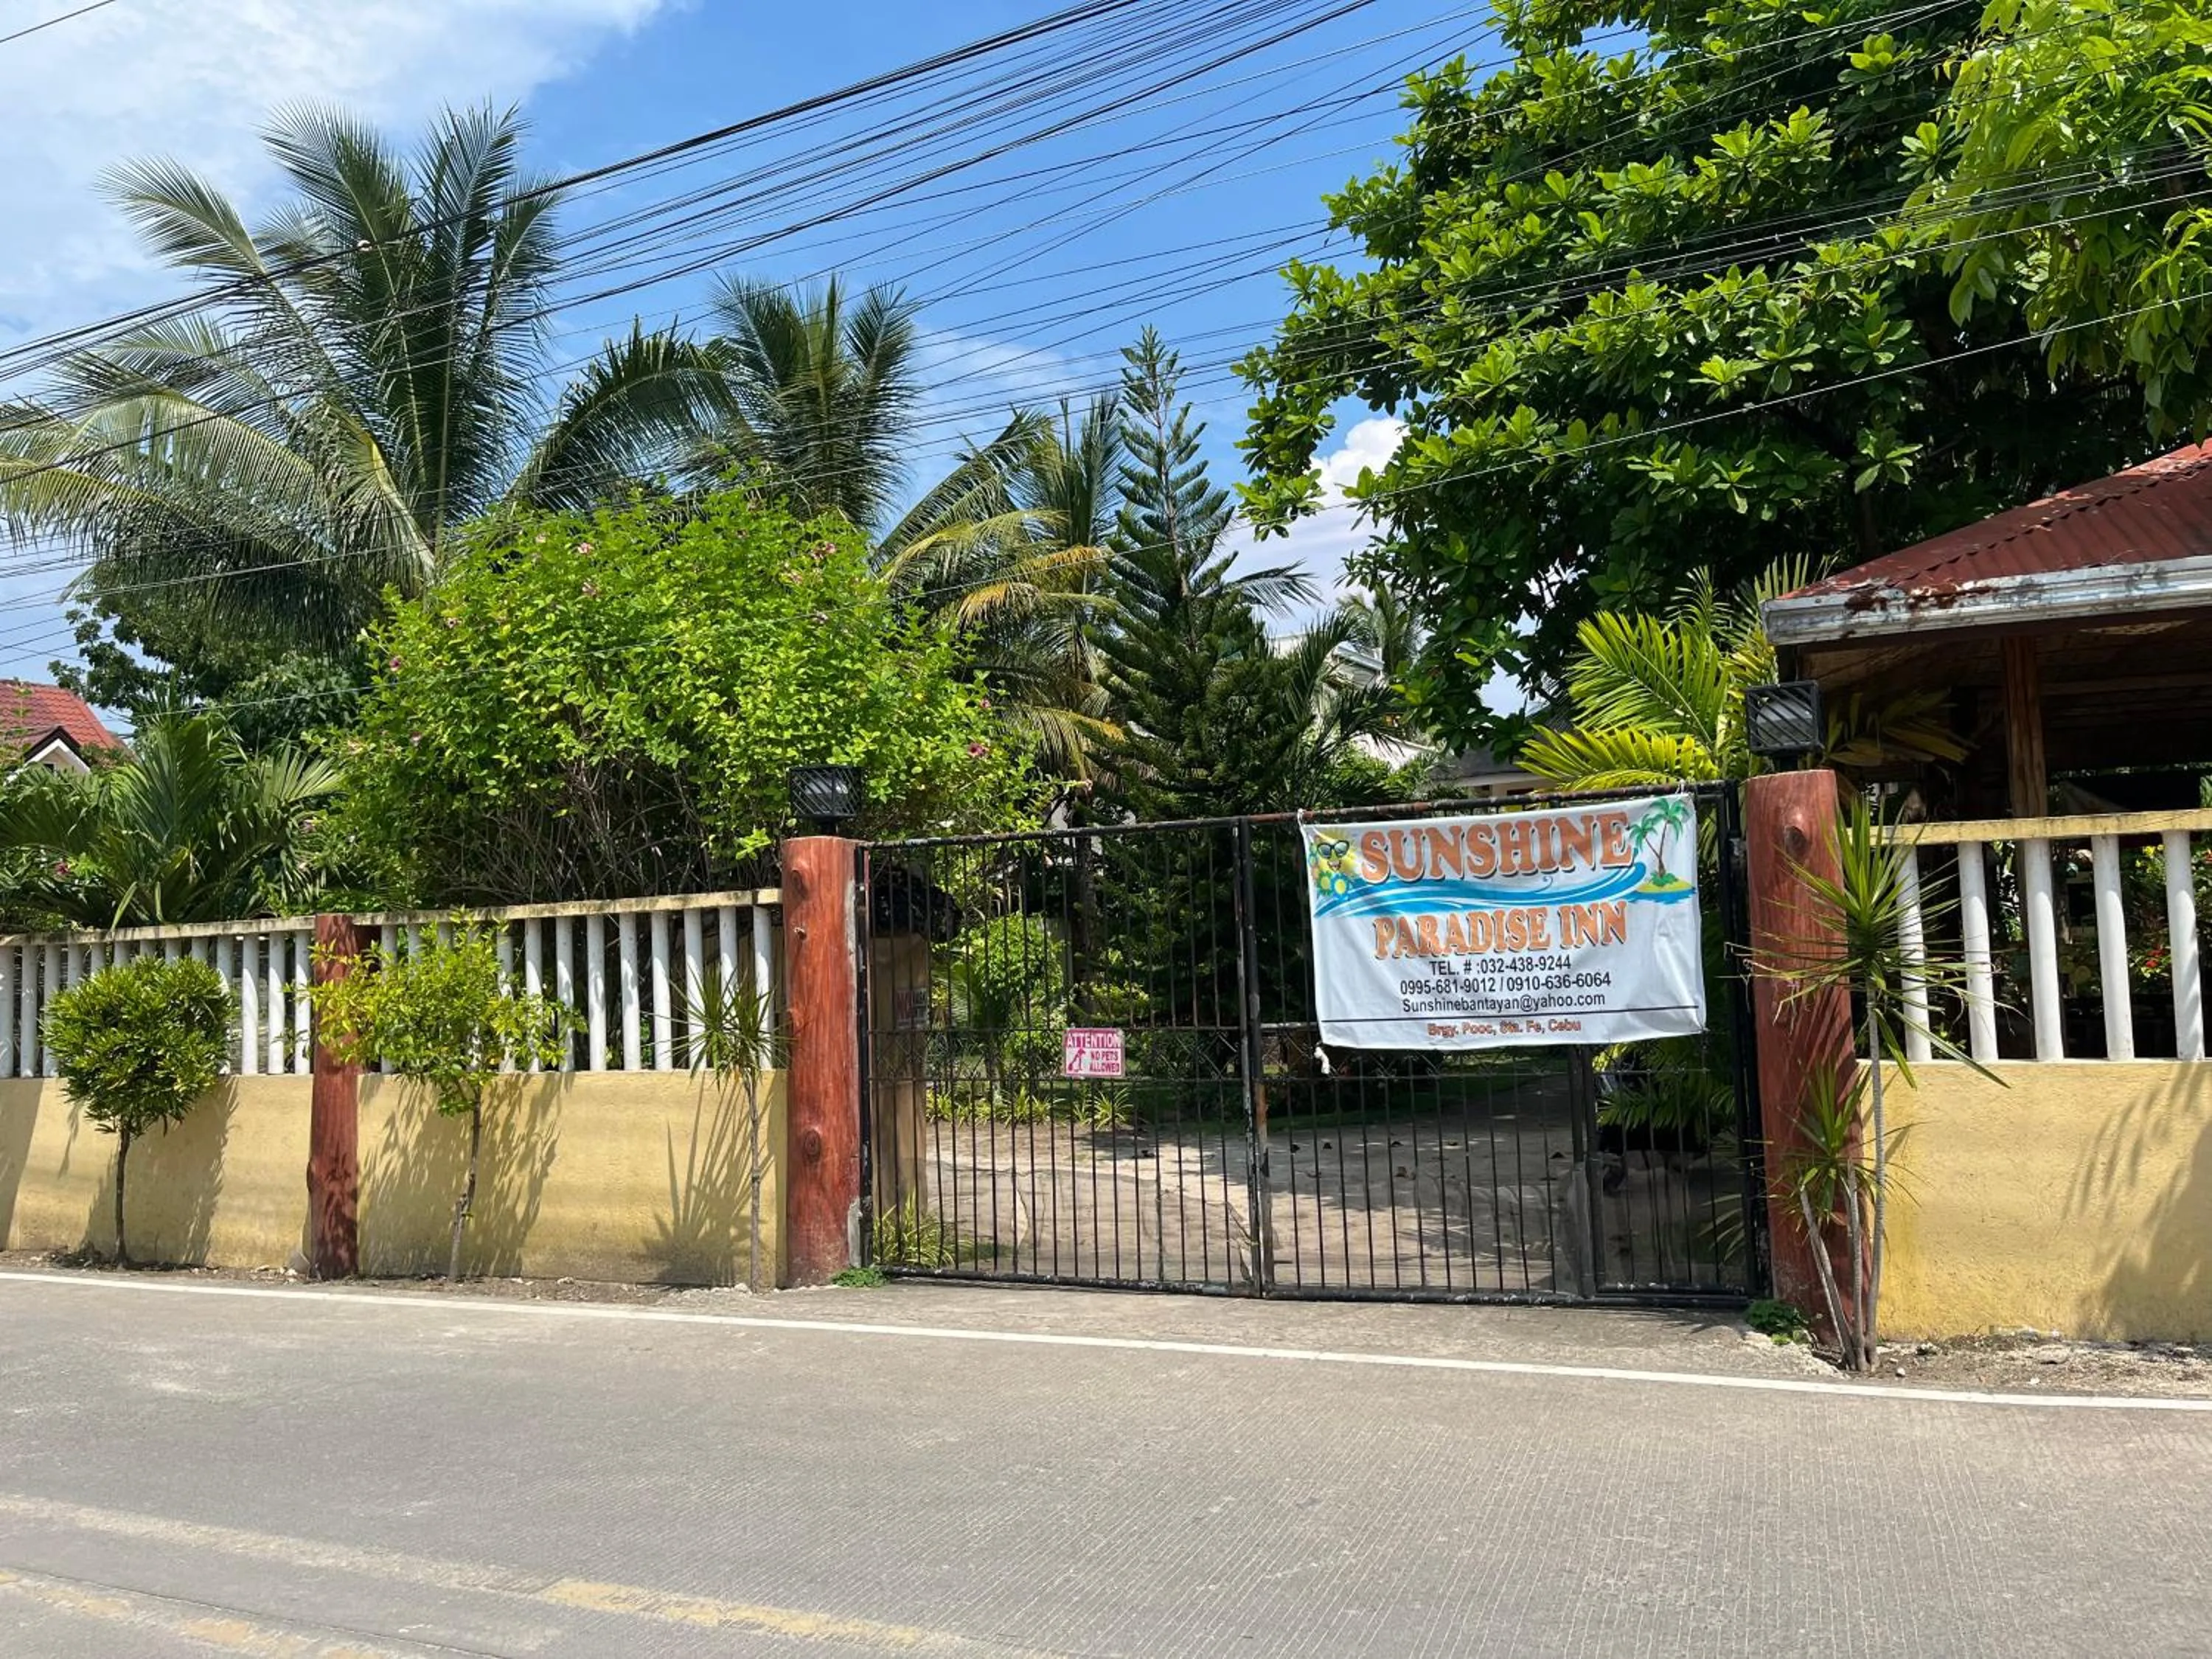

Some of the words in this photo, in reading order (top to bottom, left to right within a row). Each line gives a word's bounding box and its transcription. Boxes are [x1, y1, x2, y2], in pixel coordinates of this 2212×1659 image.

[1360, 812, 1633, 884] SUNSHINE
[1374, 906, 1551, 959] PARADISE
[1558, 900, 1627, 949] INN
[1429, 961, 1459, 975] TEL.
[1464, 959, 1472, 975] #
[1401, 977, 1496, 995] 0995-681-9012
[1506, 971, 1611, 992] 0910-636-6064
[1402, 993, 1605, 1013] Sunshinebantayan@yahoo.com
[1526, 1020, 1545, 1034] Fe,
[1548, 1018, 1581, 1032] Cebu
[1067, 1032, 1120, 1048] ATTENTION
[1091, 1051, 1100, 1060] NO
[1102, 1051, 1119, 1061] PETS
[1090, 1062, 1120, 1073] ALLOWED
